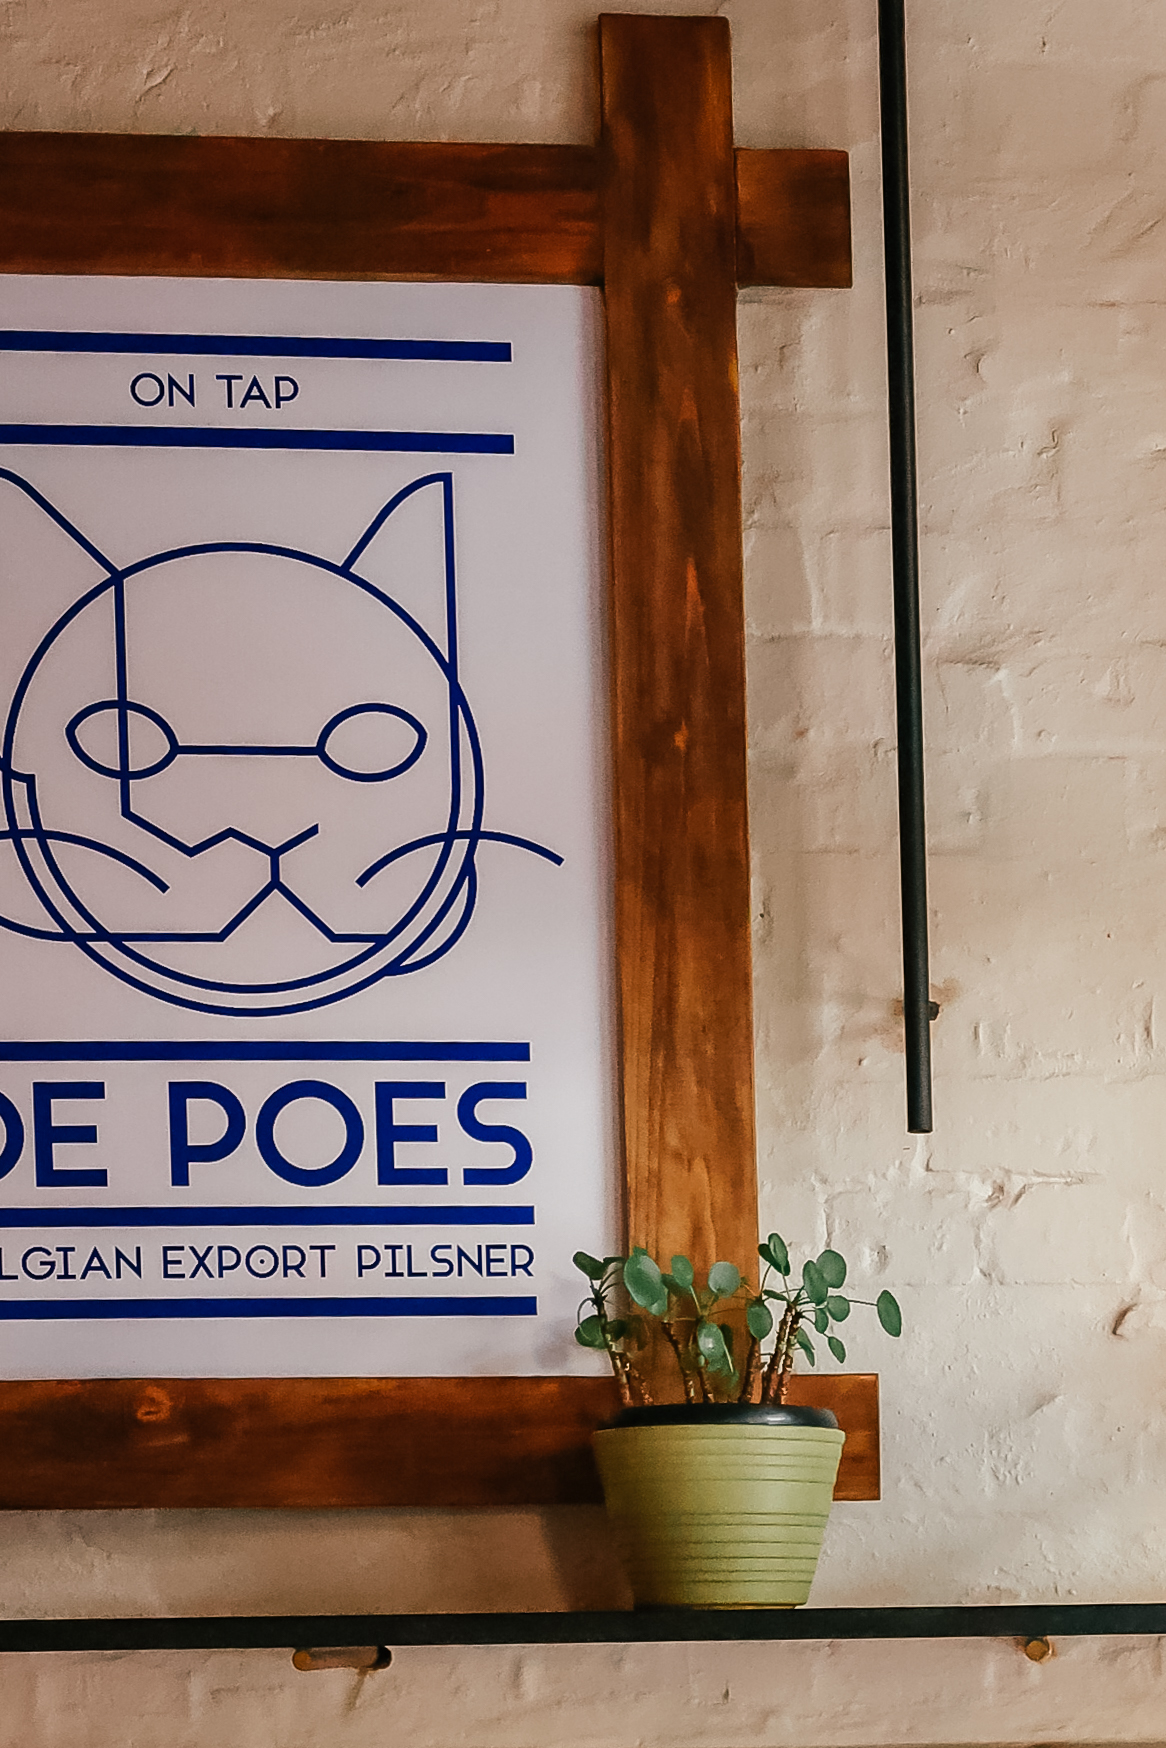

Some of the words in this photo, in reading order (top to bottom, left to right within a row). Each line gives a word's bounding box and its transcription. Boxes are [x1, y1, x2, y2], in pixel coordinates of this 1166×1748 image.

[129, 372, 196, 408] ON
[215, 374, 299, 409] TAP
[0, 1081, 109, 1188] E
[167, 1079, 534, 1188] POES
[0, 1246, 142, 1281] LGIAN
[162, 1244, 336, 1279] EXPORT
[357, 1244, 535, 1278] PILSNER
